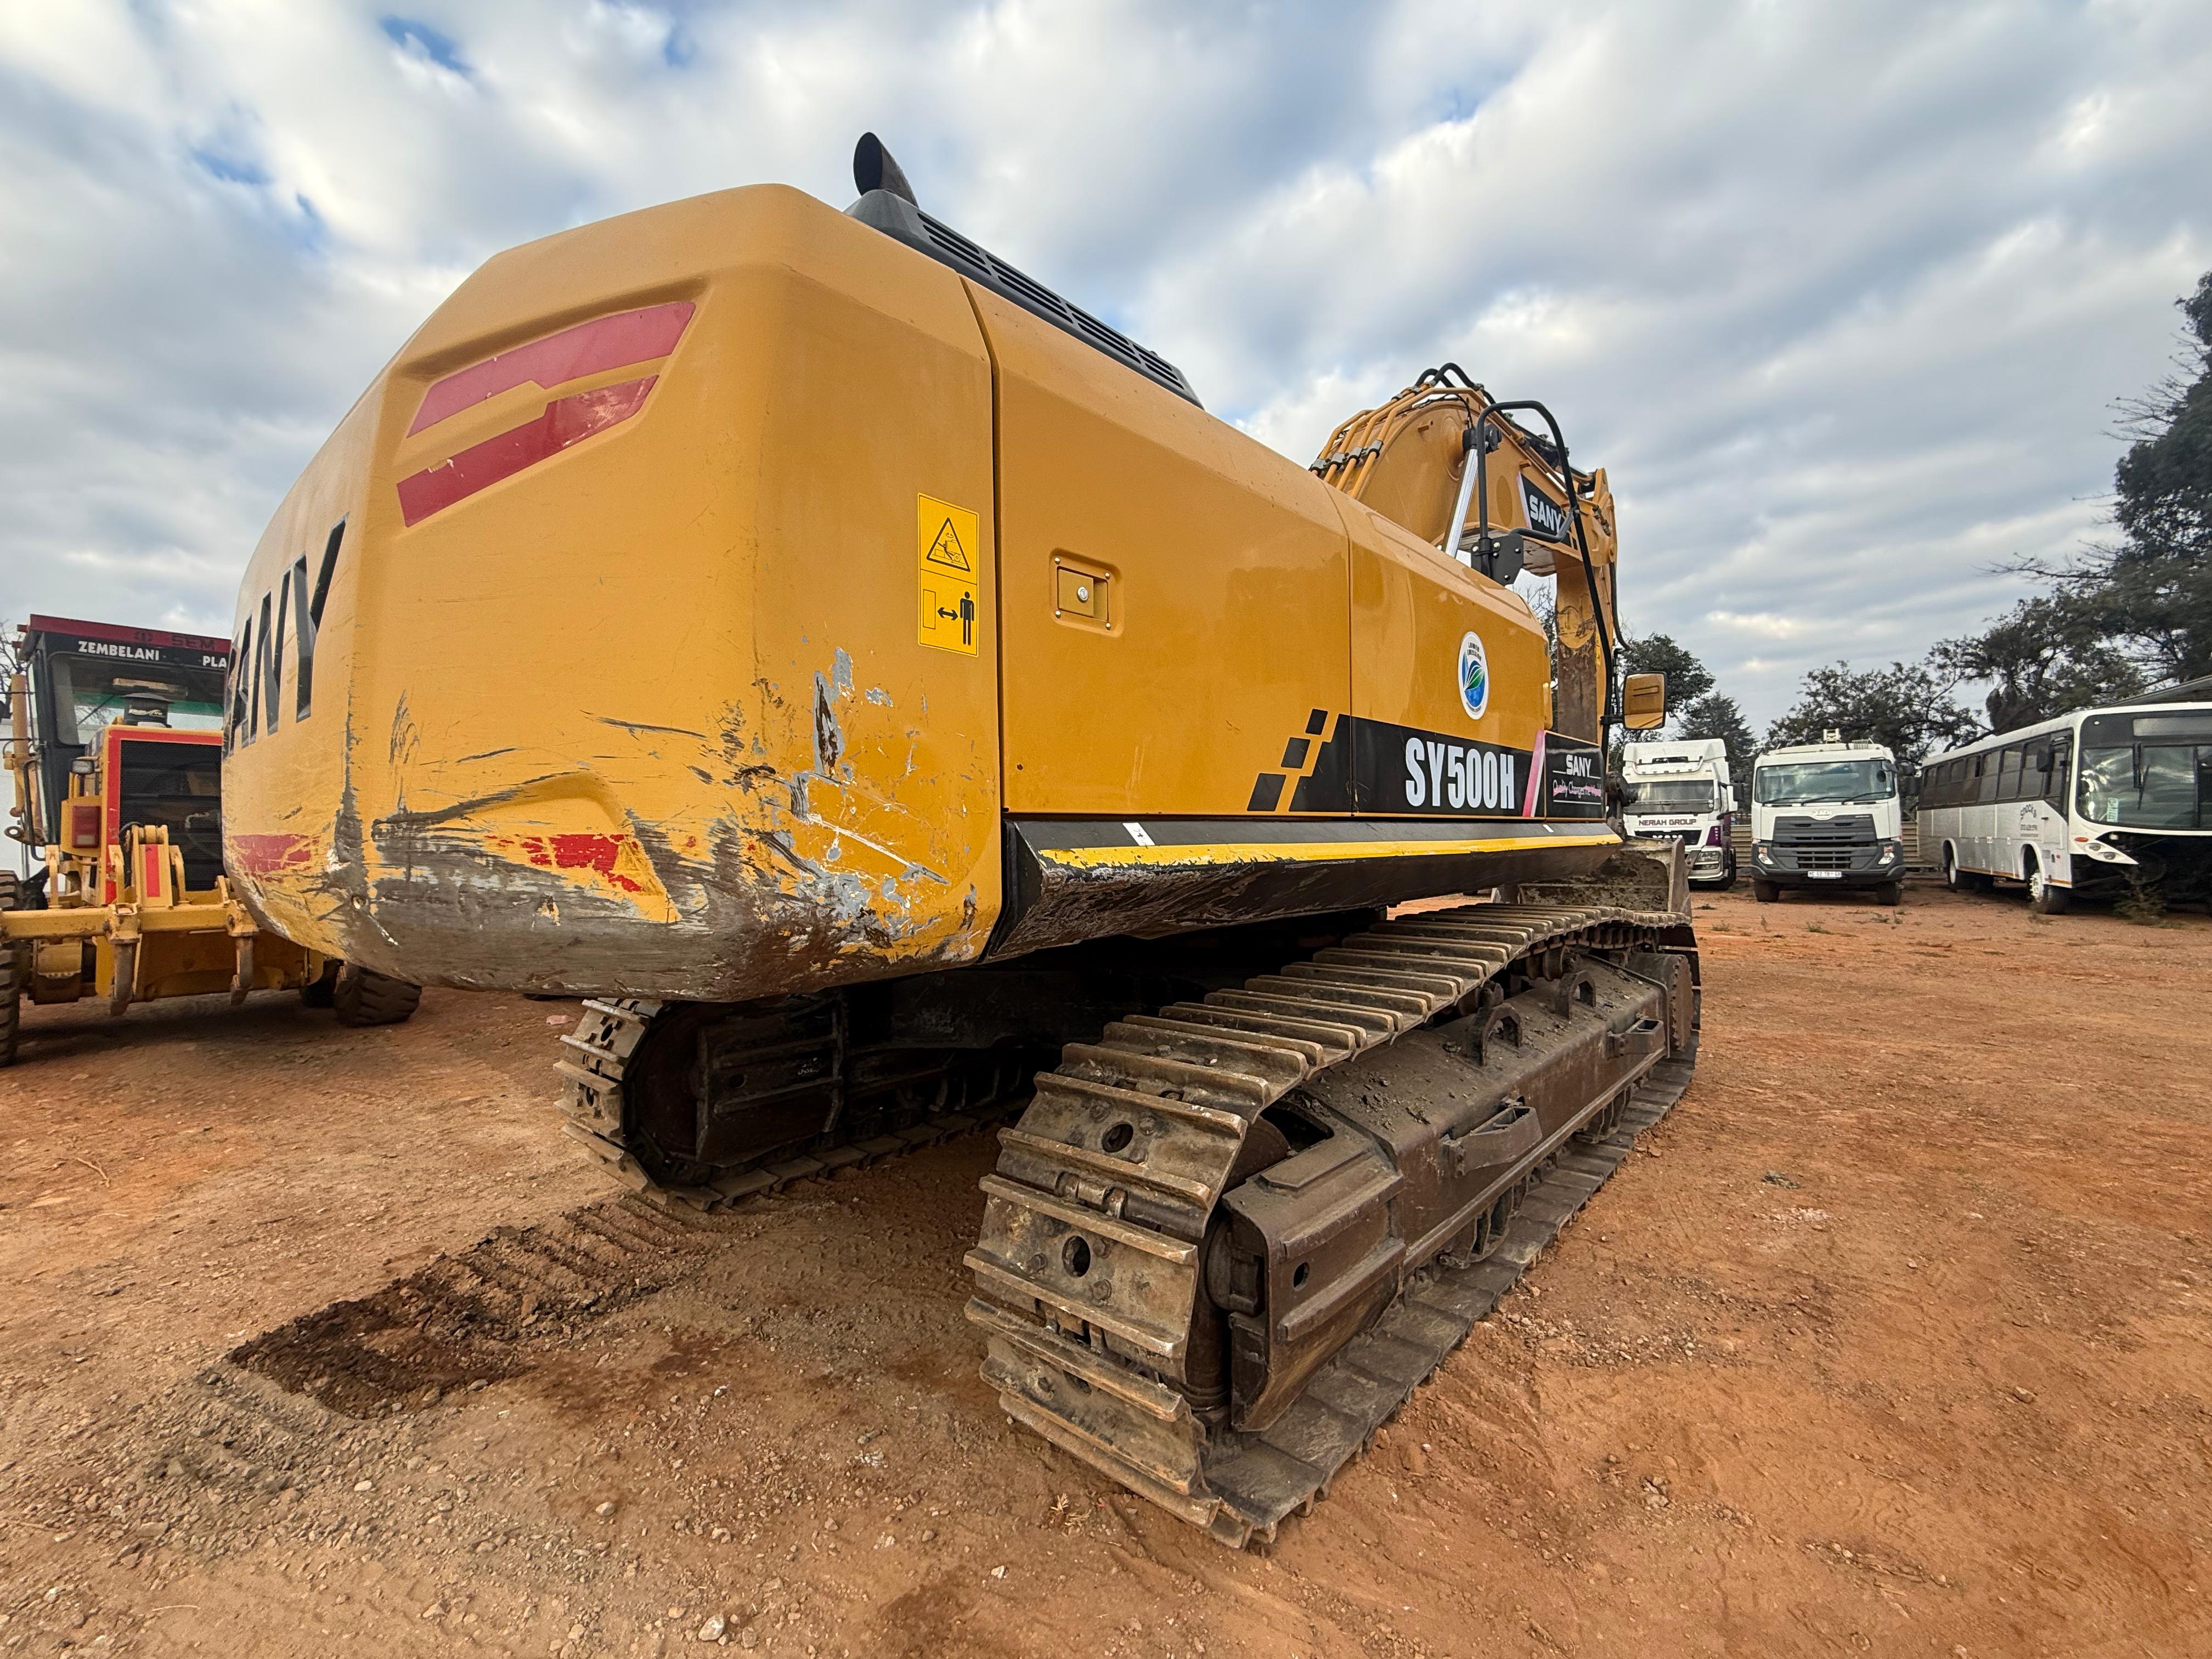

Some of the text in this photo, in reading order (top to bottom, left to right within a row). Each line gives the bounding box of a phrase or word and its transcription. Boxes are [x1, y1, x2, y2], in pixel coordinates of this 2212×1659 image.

[1529, 494, 1562, 535] SANY
[78, 640, 160, 661] ZEMBELANI
[171, 634, 216, 651] SEM
[1405, 737, 1515, 809] SY500H
[1566, 754, 1592, 778] SANY
